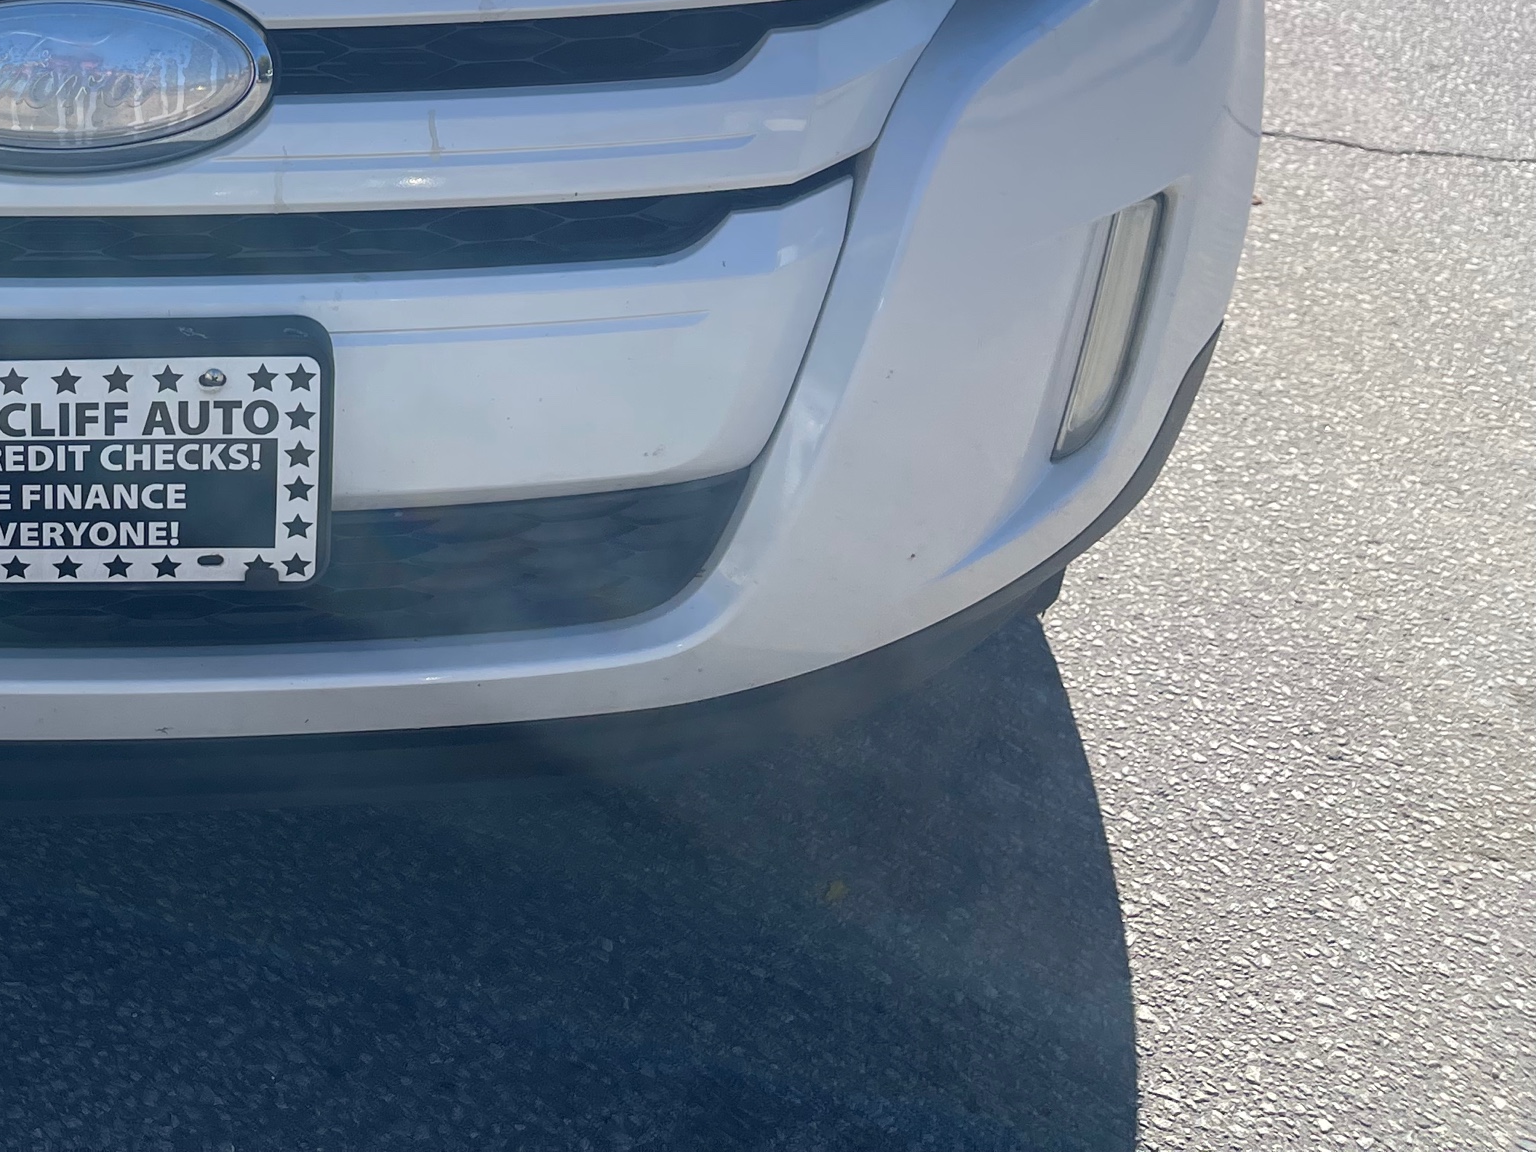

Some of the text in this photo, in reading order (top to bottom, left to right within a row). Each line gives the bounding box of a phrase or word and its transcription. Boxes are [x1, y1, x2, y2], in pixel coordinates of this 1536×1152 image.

[142, 399, 280, 436] AUTO
[99, 442, 262, 471] CHECKS!
[22, 482, 187, 510] FINANCE
